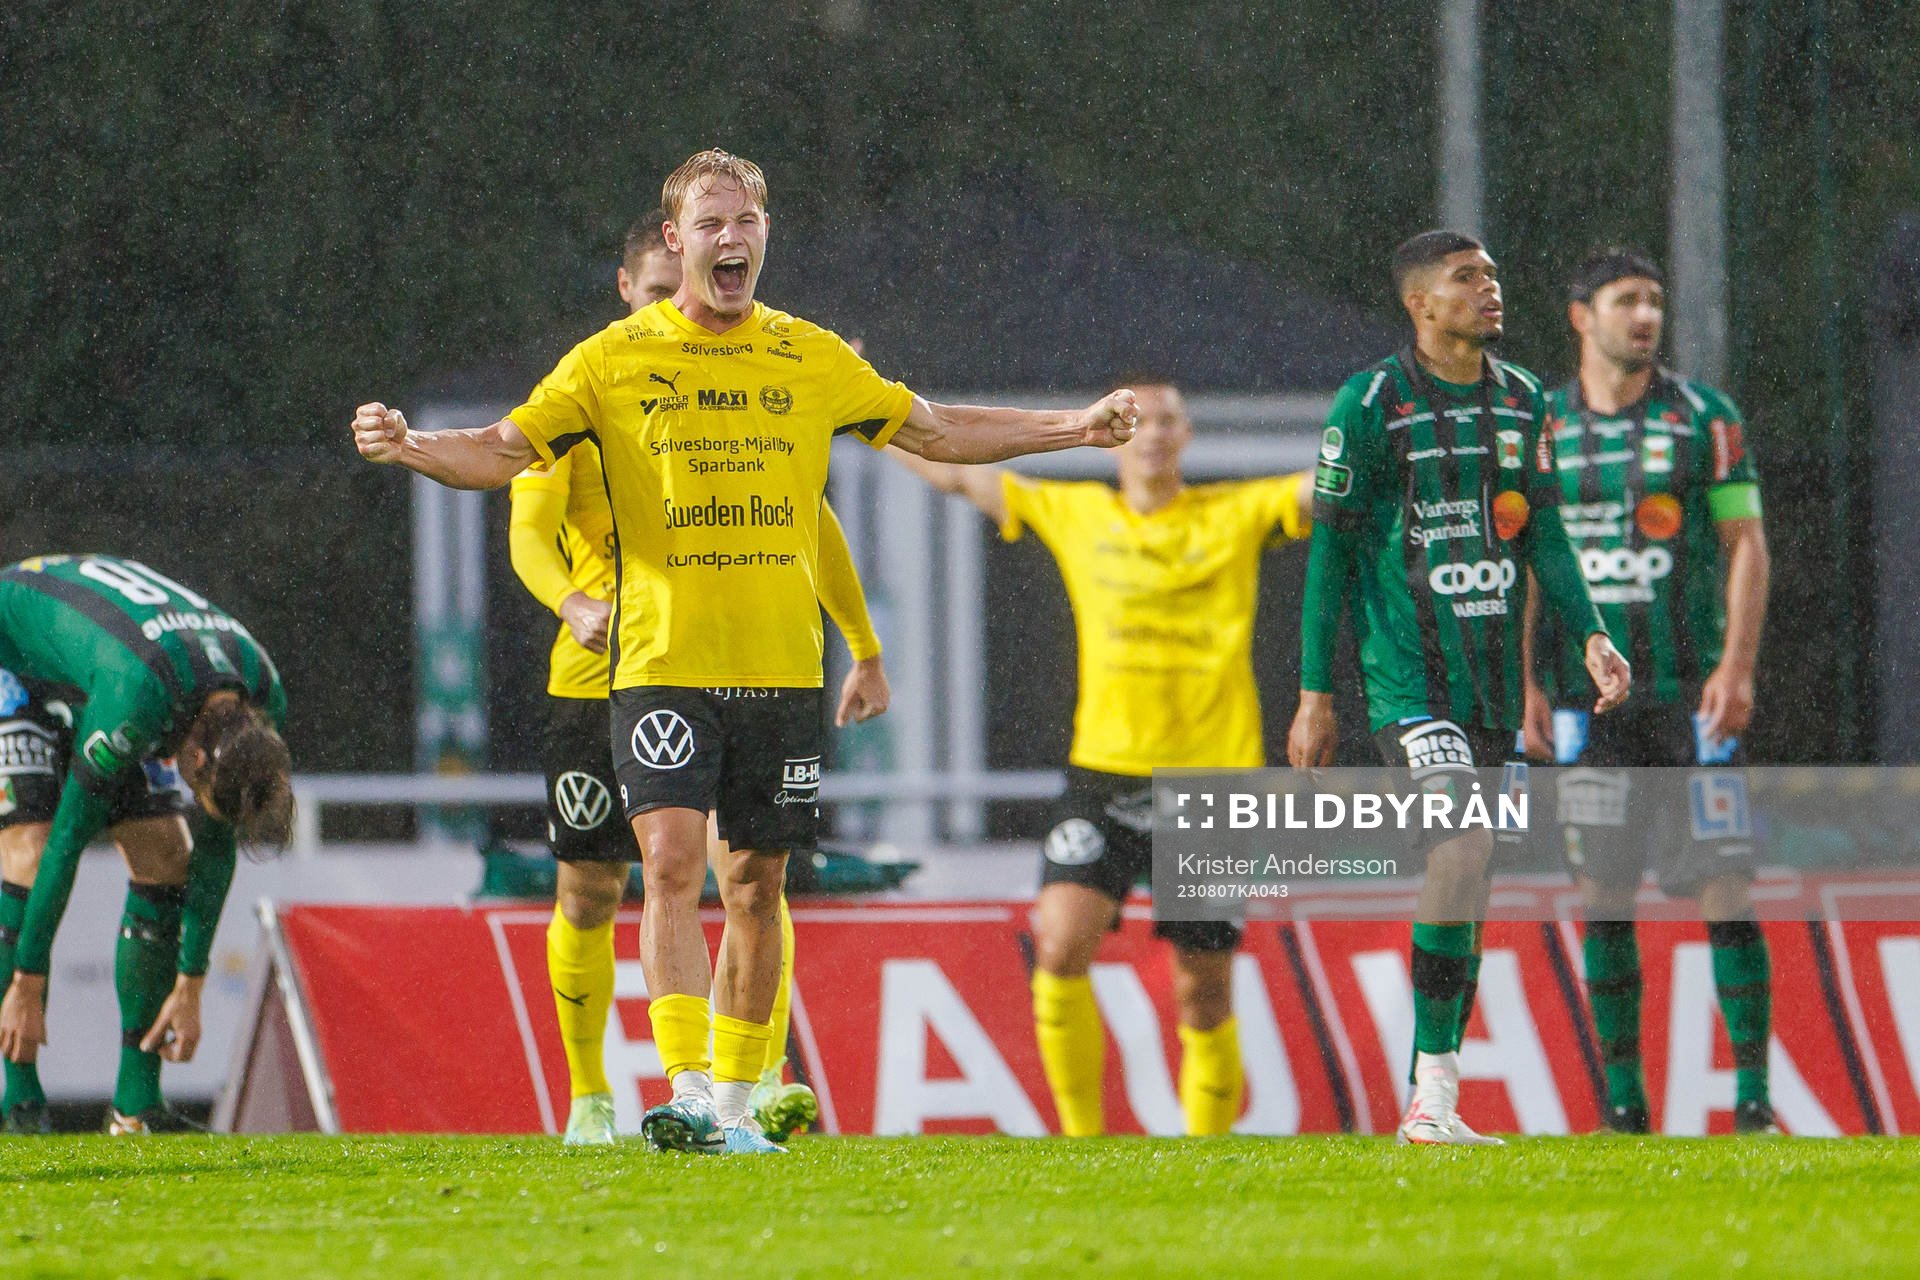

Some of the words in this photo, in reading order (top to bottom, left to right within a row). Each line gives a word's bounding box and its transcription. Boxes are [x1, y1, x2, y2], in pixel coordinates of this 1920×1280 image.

[681, 342, 753, 356] Sölvesborg
[659, 395, 689, 405] INTER
[659, 402, 689, 412] SPORT
[650, 437, 795, 456] Sölvesborg-Mjällby
[688, 458, 765, 475] Sparbank
[664, 495, 745, 529] Sweden
[750, 495, 794, 528] Rock
[666, 551, 797, 571] Kundpartner
[1578, 547, 1674, 587] oop
